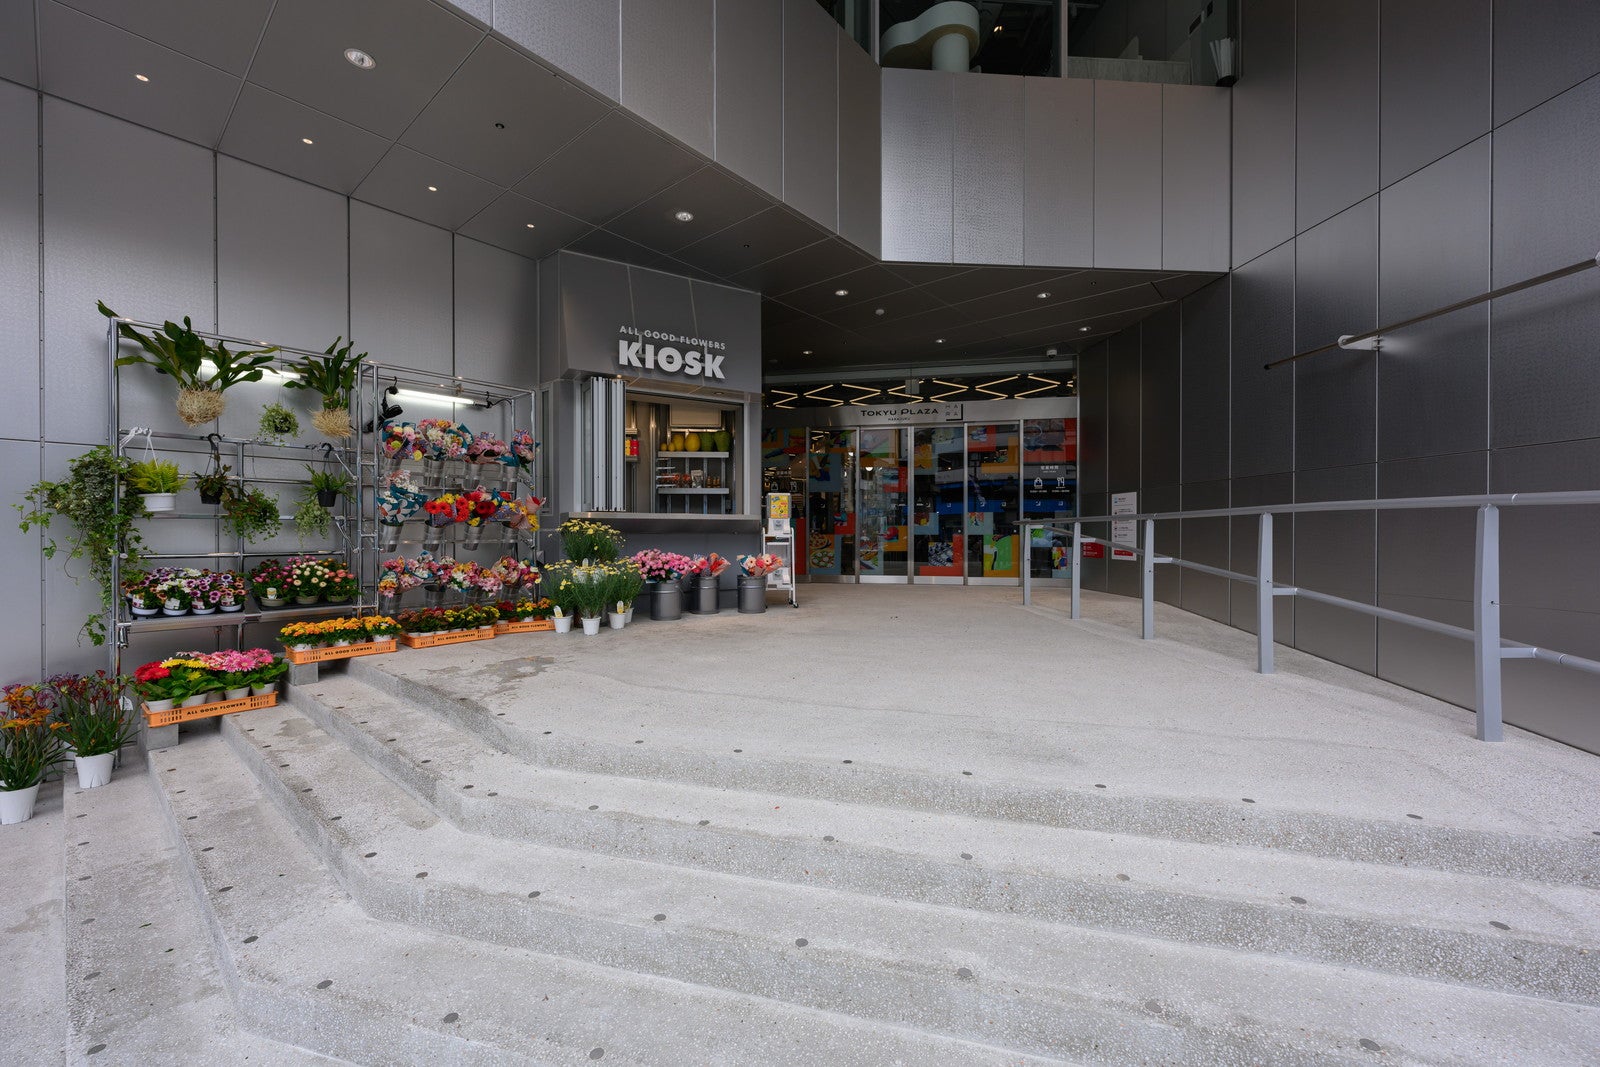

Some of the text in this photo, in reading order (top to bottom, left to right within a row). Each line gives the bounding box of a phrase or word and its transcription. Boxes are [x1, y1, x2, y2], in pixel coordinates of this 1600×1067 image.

[619, 325, 726, 351] ALL GOOD FLOWERS
[618, 339, 726, 379] KIOSK
[220, 702, 246, 710] FLOWERS
